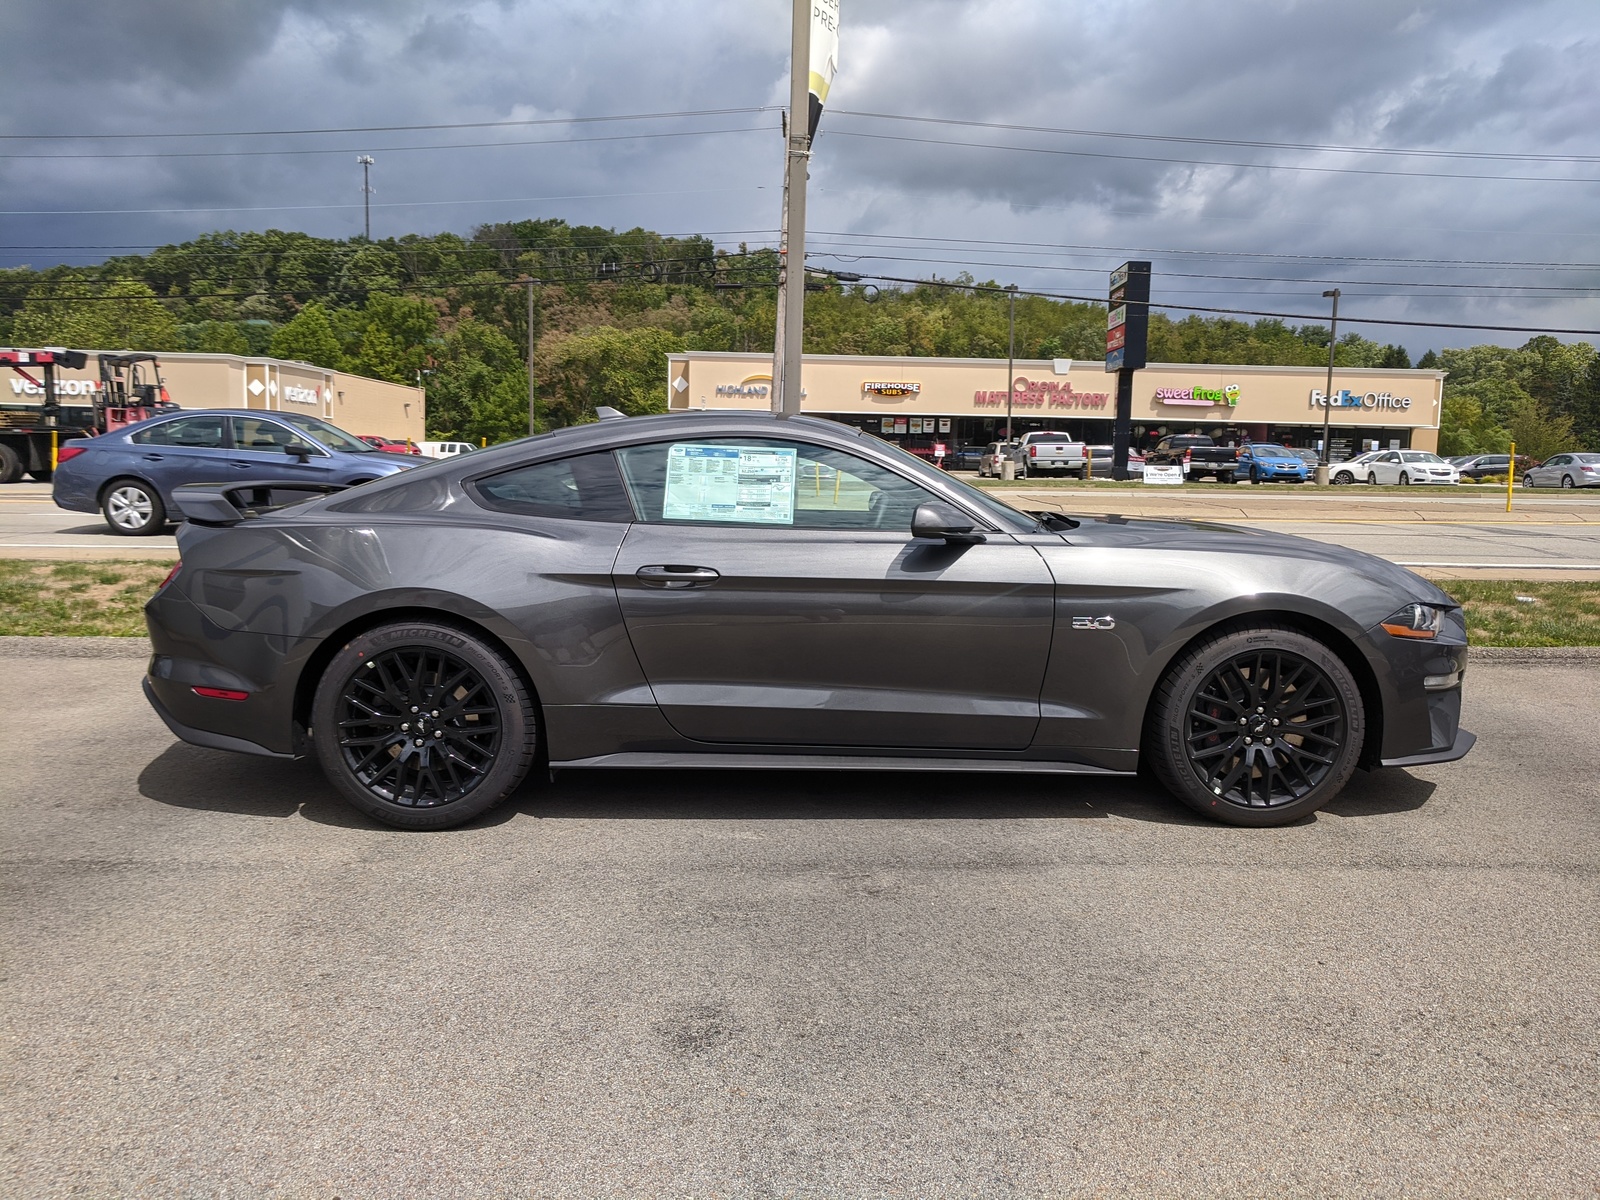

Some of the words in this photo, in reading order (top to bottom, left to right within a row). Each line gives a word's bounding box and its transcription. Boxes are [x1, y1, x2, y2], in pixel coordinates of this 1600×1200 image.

[814, 6, 839, 38] PRE-
[716, 385, 768, 396] HIGHLAND
[864, 382, 920, 393] FIREHOUSE
[1013, 376, 1073, 392] ORIGINAL
[284, 384, 317, 404] verizon
[975, 391, 1044, 405] MATTRESS
[1048, 392, 1109, 407] FACTORY
[1156, 386, 1223, 401] sweetFrog
[1071, 615, 1115, 630] 5.0
[390, 628, 462, 647] MICHELIN
[1333, 669, 1360, 730] MICHELIN
[1170, 730, 1198, 790] MICHELIN
